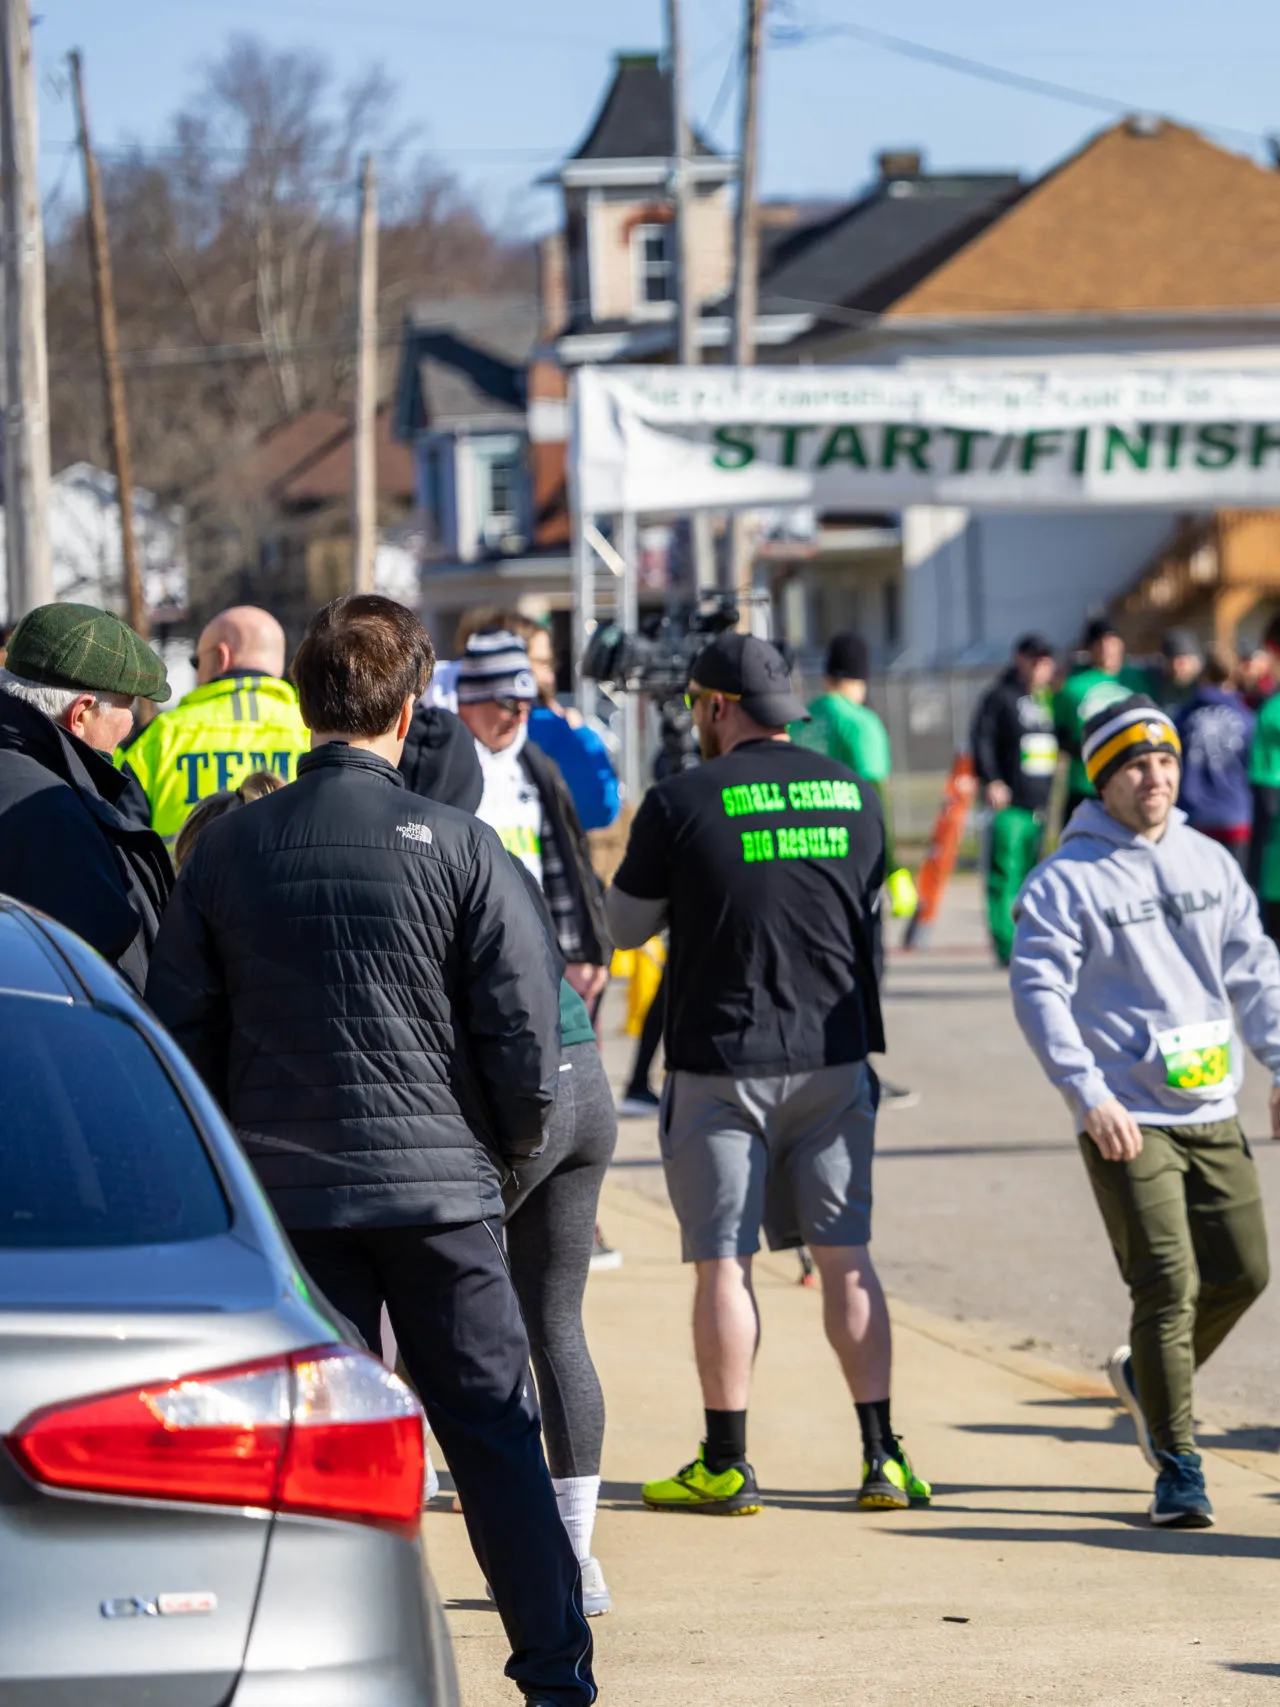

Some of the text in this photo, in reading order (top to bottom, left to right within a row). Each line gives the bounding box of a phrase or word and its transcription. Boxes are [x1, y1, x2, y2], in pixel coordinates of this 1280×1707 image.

[395, 825, 421, 834] NORTH
[407, 821, 421, 830] THE
[401, 832, 421, 841] FACE
[741, 829, 774, 862] BIG
